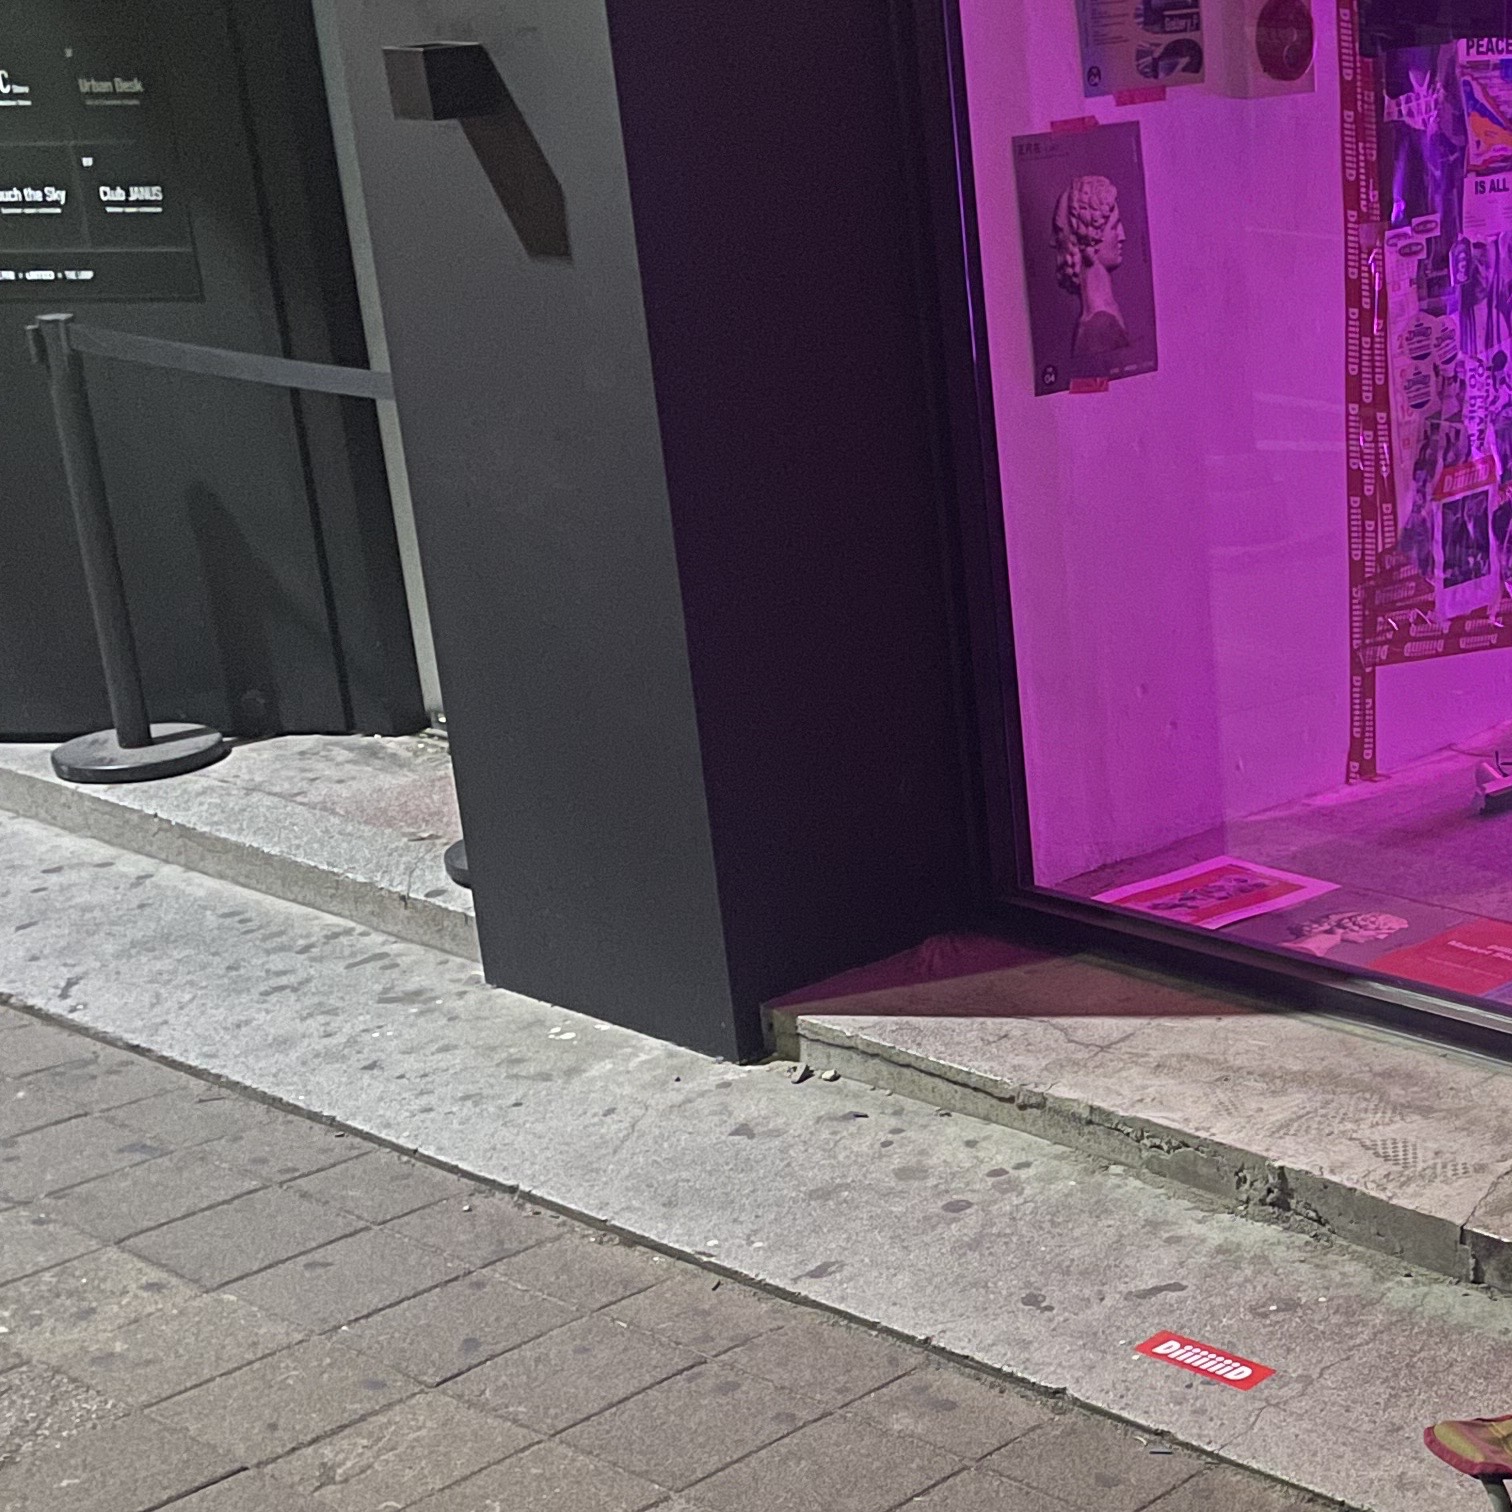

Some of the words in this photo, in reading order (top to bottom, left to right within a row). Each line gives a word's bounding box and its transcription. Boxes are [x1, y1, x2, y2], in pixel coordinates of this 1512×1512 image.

[99, 185, 126, 202] Club
[128, 185, 163, 201] JANUS
[1474, 180, 1487, 195] IS
[1488, 177, 1510, 194] ALL
[44, 186, 66, 206] Sky
